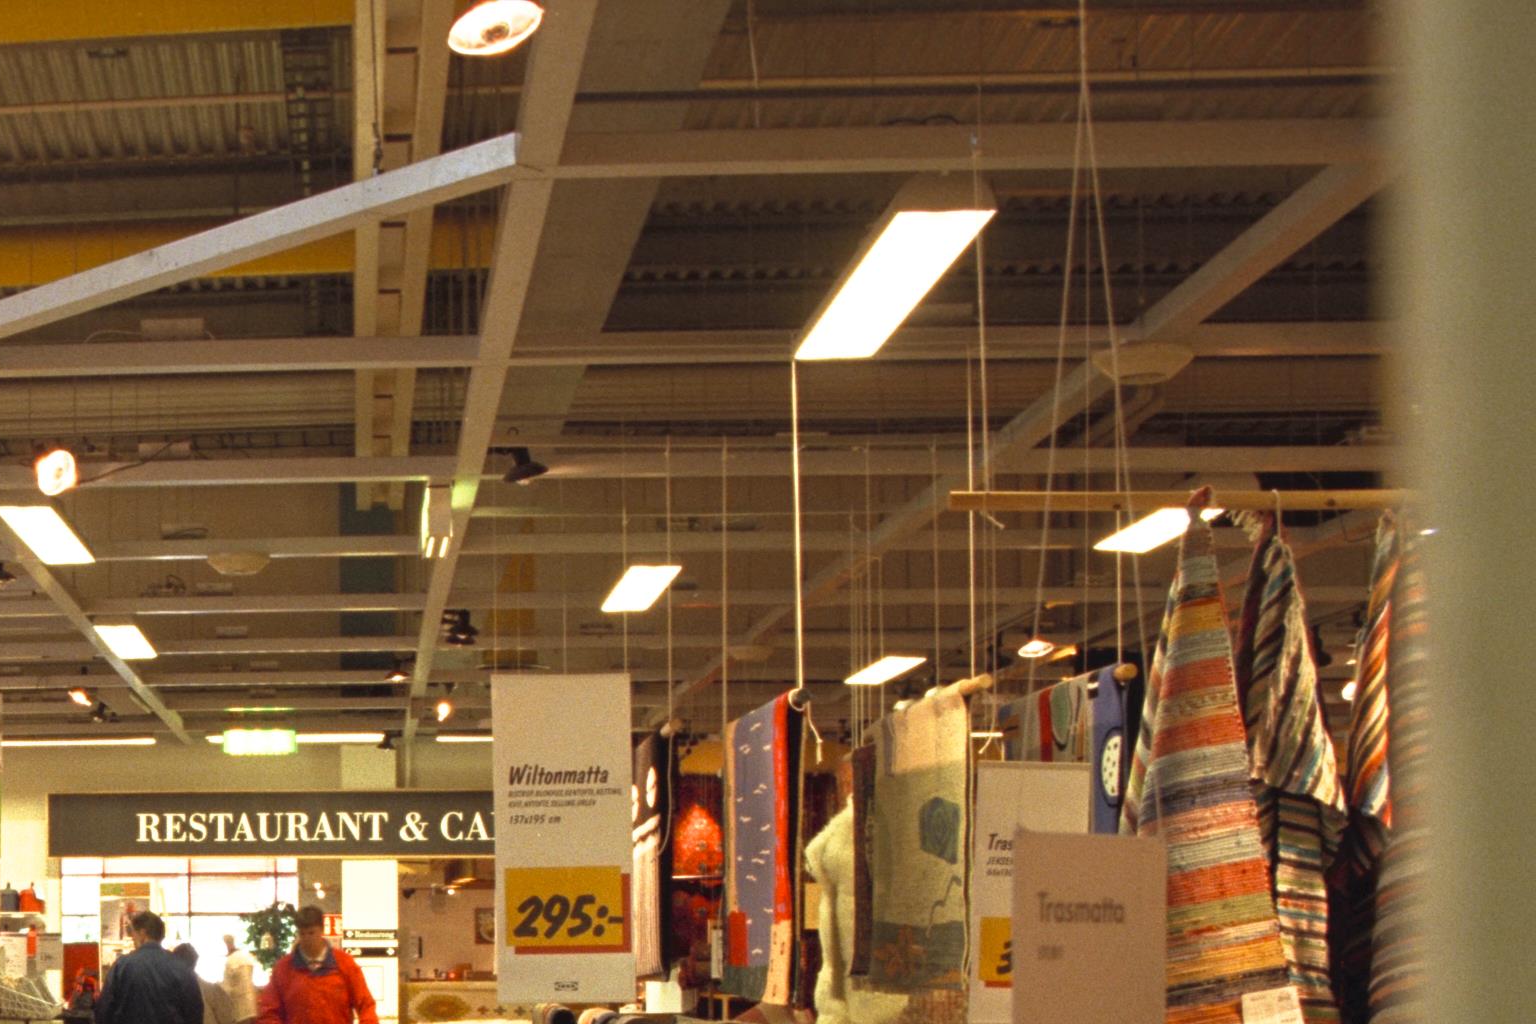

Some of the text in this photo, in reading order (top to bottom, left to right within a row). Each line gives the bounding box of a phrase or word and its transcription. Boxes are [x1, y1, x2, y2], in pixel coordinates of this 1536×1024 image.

[509, 764, 609, 785] Wiltonmatta
[137, 811, 495, 842] RESTAURANT & CA
[988, 833, 1013, 850] Tras
[513, 894, 624, 939] 295:-
[1037, 891, 1125, 924] Trasmatta
